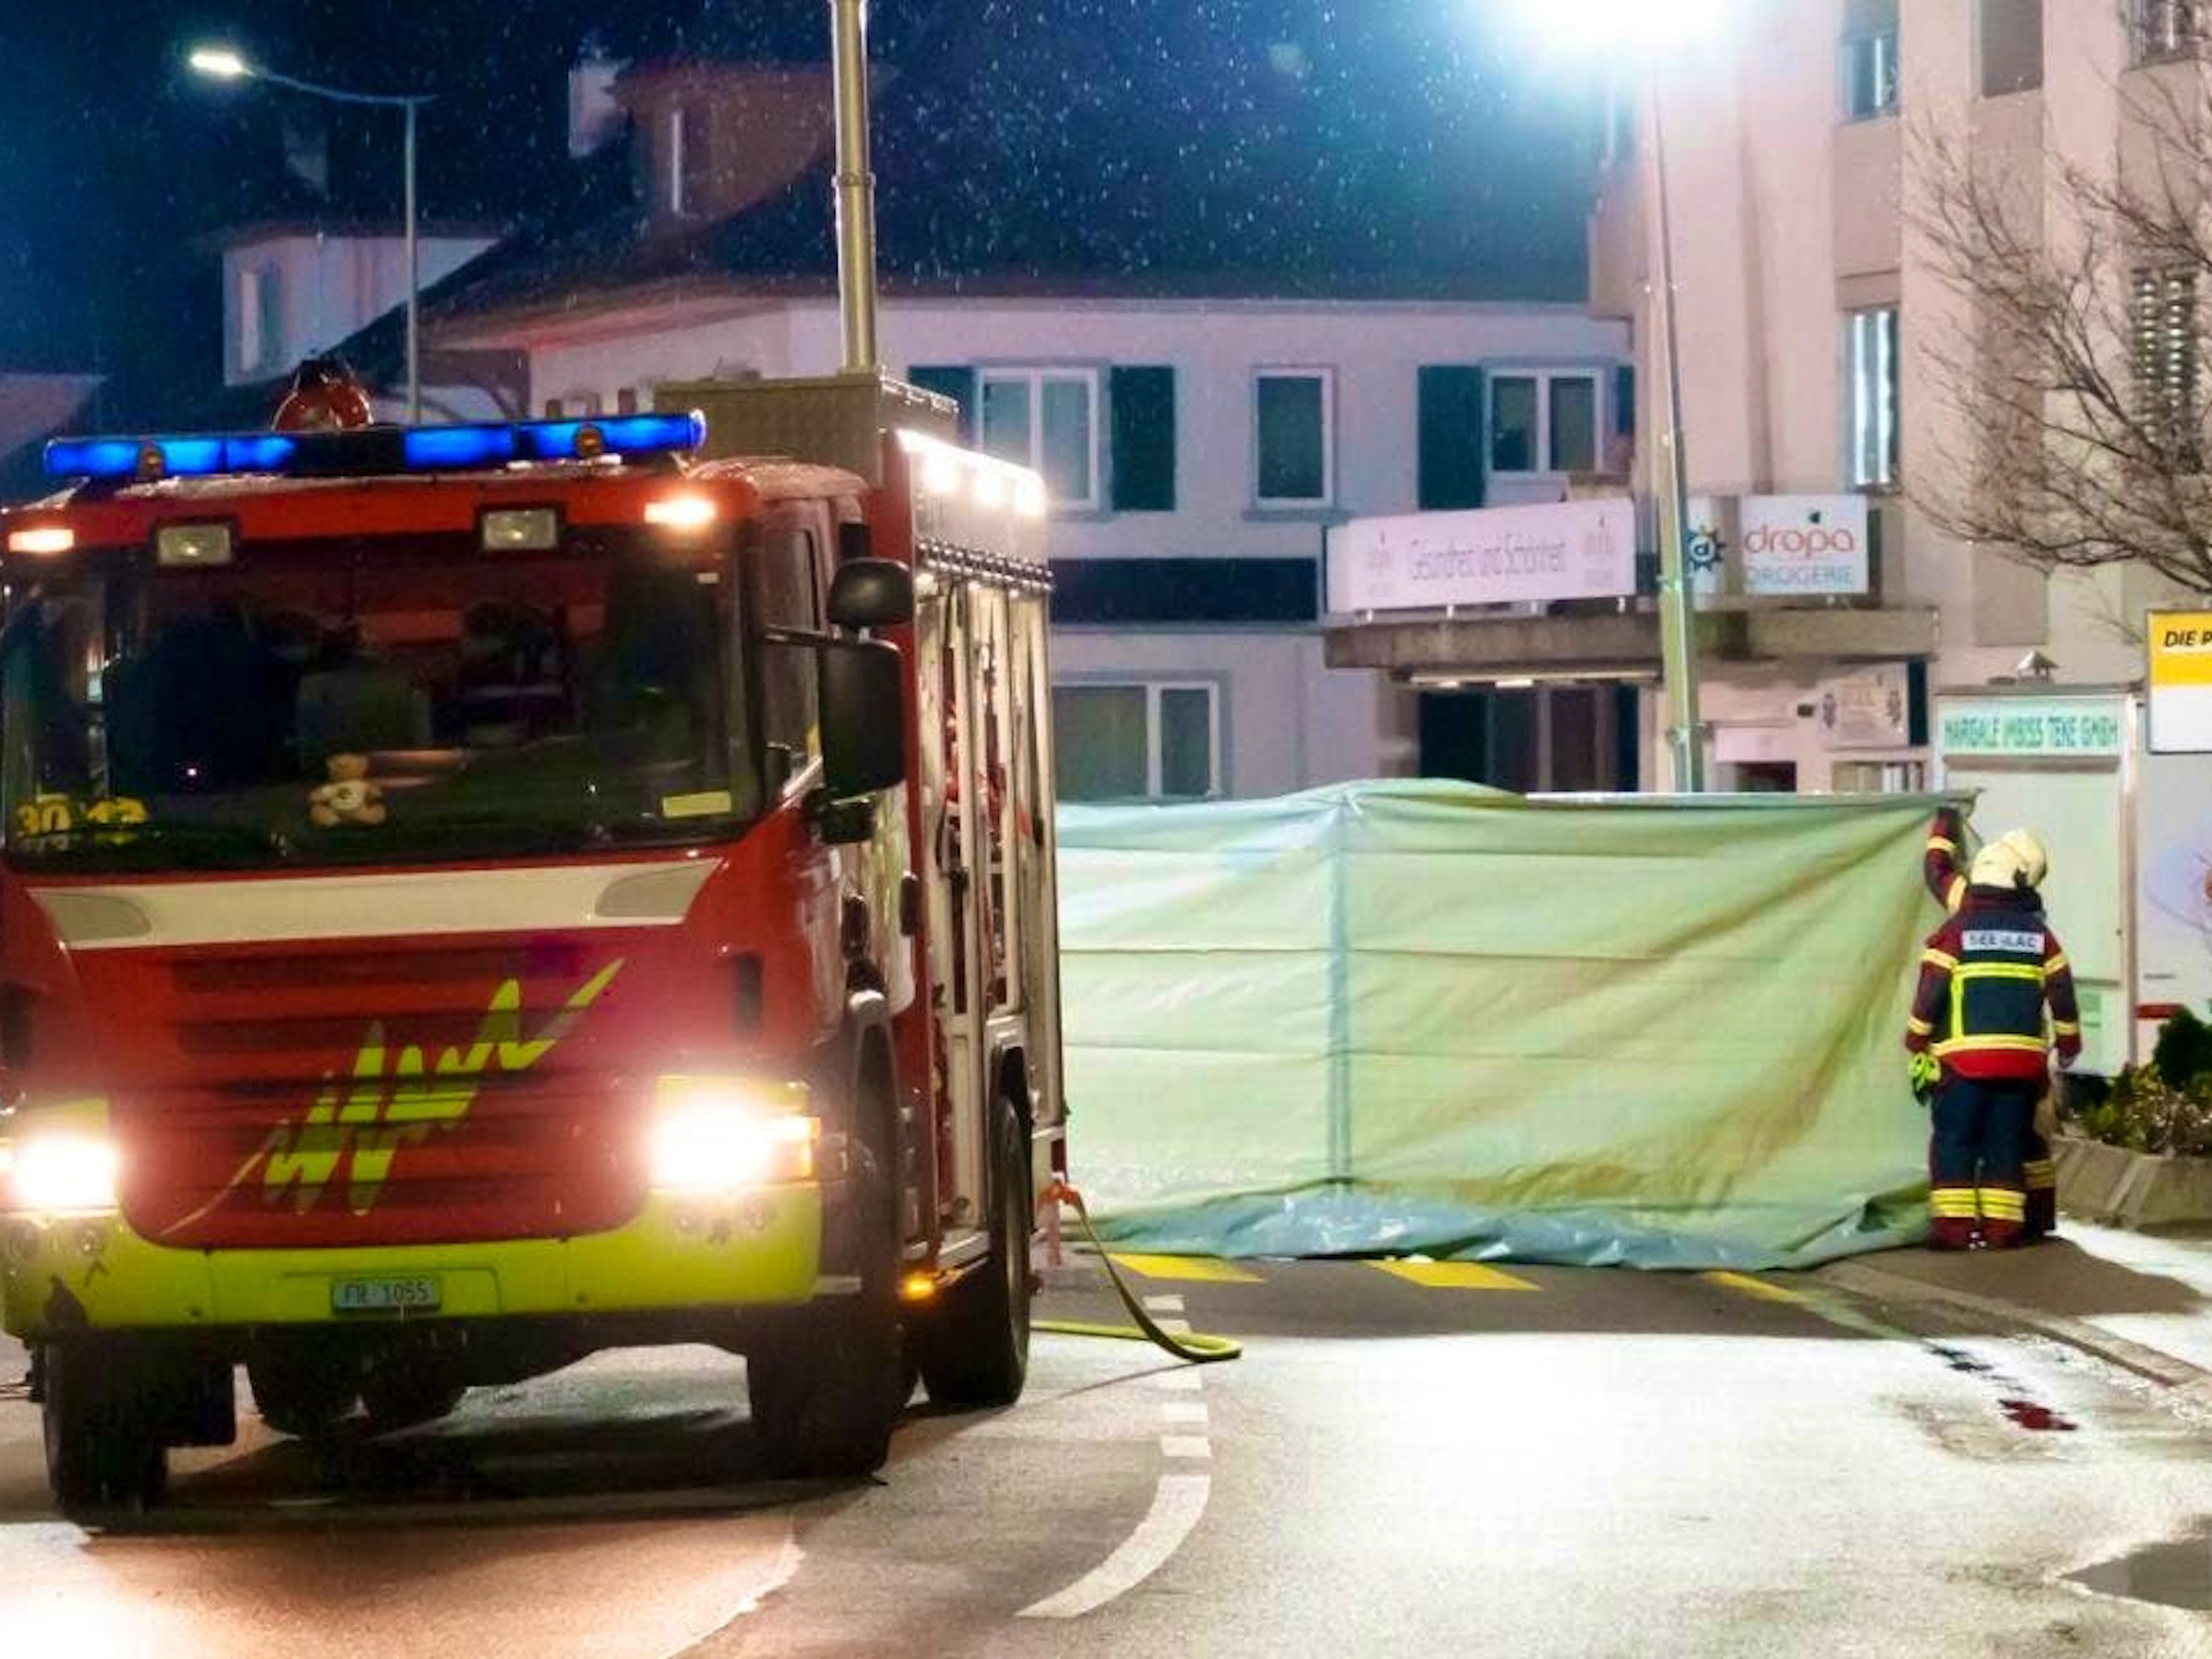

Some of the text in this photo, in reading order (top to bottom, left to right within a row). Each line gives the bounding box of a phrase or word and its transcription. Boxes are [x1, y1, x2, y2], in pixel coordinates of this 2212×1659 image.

[1744, 523, 1854, 559] dropa
[1746, 565, 1854, 585] DROGERIE
[2165, 631, 2195, 647] DIE
[343, 1282, 368, 1304] FR
